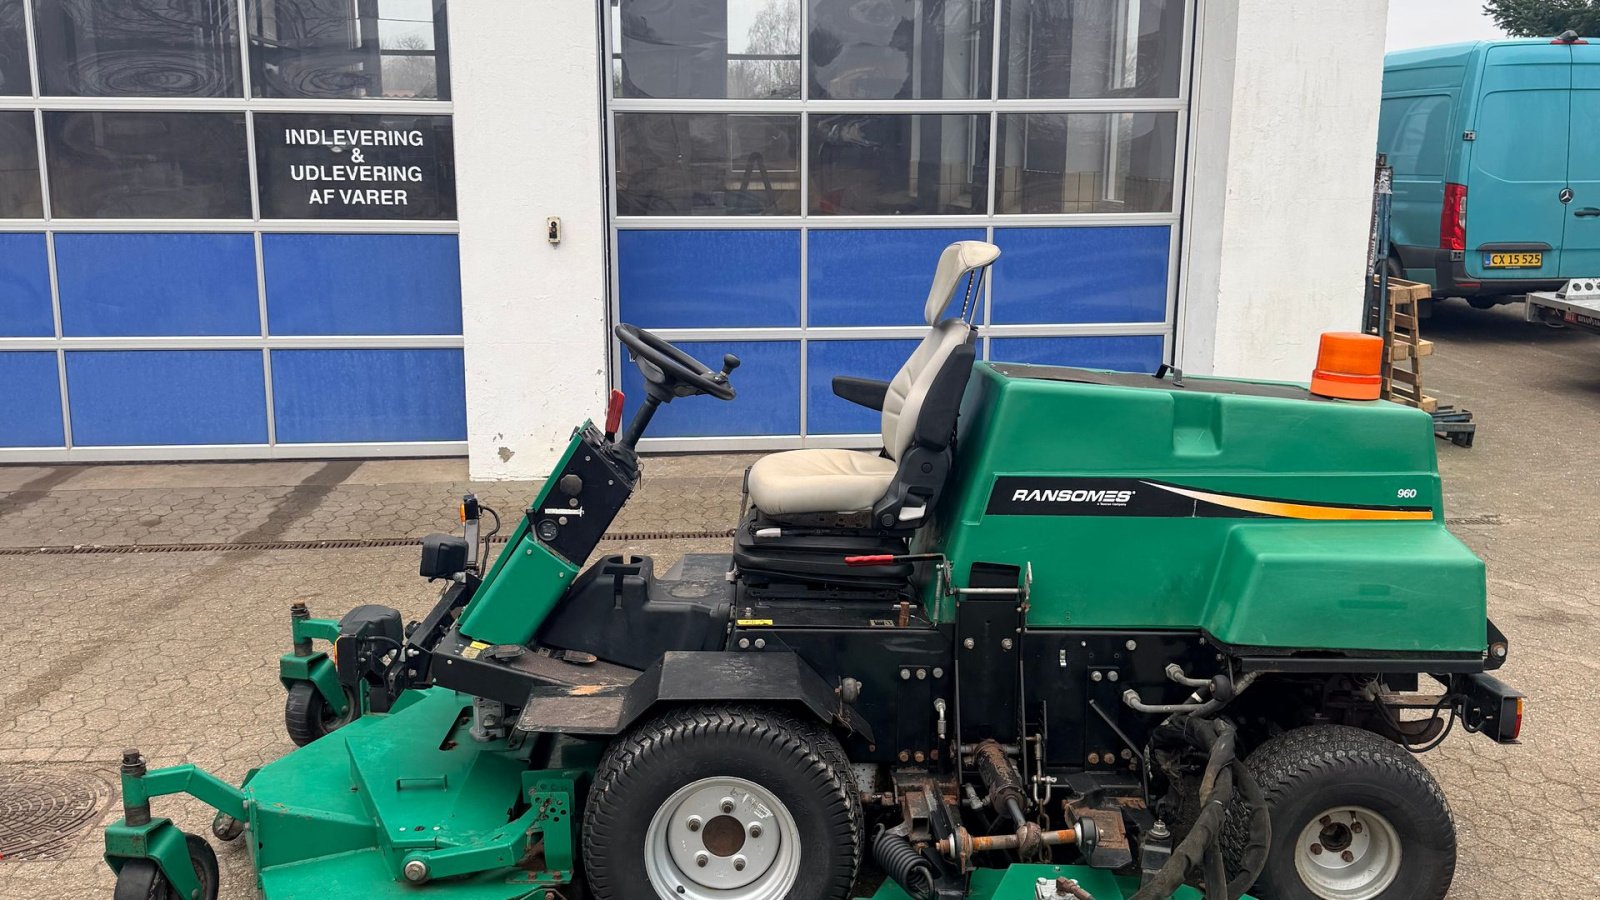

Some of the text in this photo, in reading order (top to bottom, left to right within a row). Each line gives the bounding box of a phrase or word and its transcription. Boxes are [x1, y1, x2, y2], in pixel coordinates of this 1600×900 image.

[285, 129, 424, 146] INDLEVERING
[351, 147, 365, 163] &
[290, 165, 422, 182] UDLEVERING
[309, 189, 408, 205] AF VARER
[1492, 254, 1541, 265] CX 15 525
[1012, 489, 1132, 502] RANSOMES
[1397, 488, 1417, 499] 960
